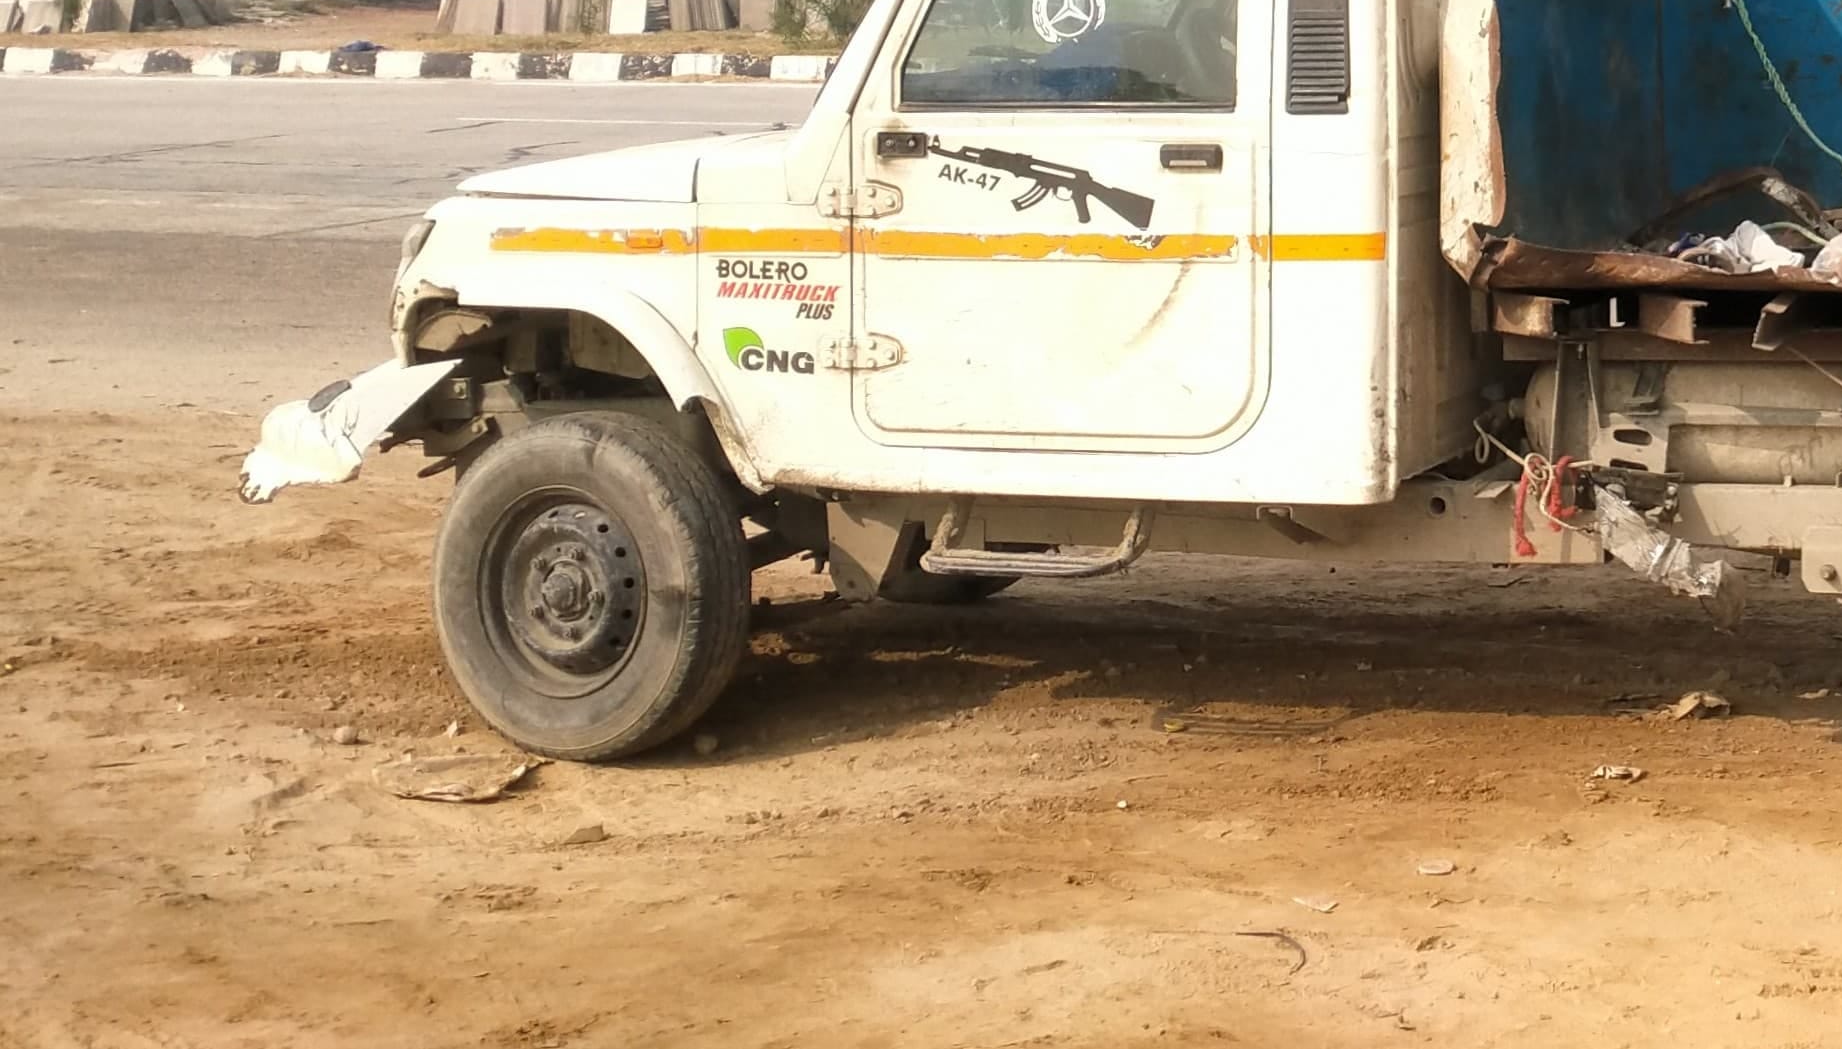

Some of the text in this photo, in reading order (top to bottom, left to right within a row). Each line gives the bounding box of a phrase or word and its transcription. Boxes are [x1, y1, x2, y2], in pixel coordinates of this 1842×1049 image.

[937, 163, 1002, 192] AK-47
[715, 258, 808, 283] BOLERO
[716, 281, 843, 303] MAXITRUCK
[795, 303, 835, 321] PLUS
[740, 348, 815, 375] CNG
